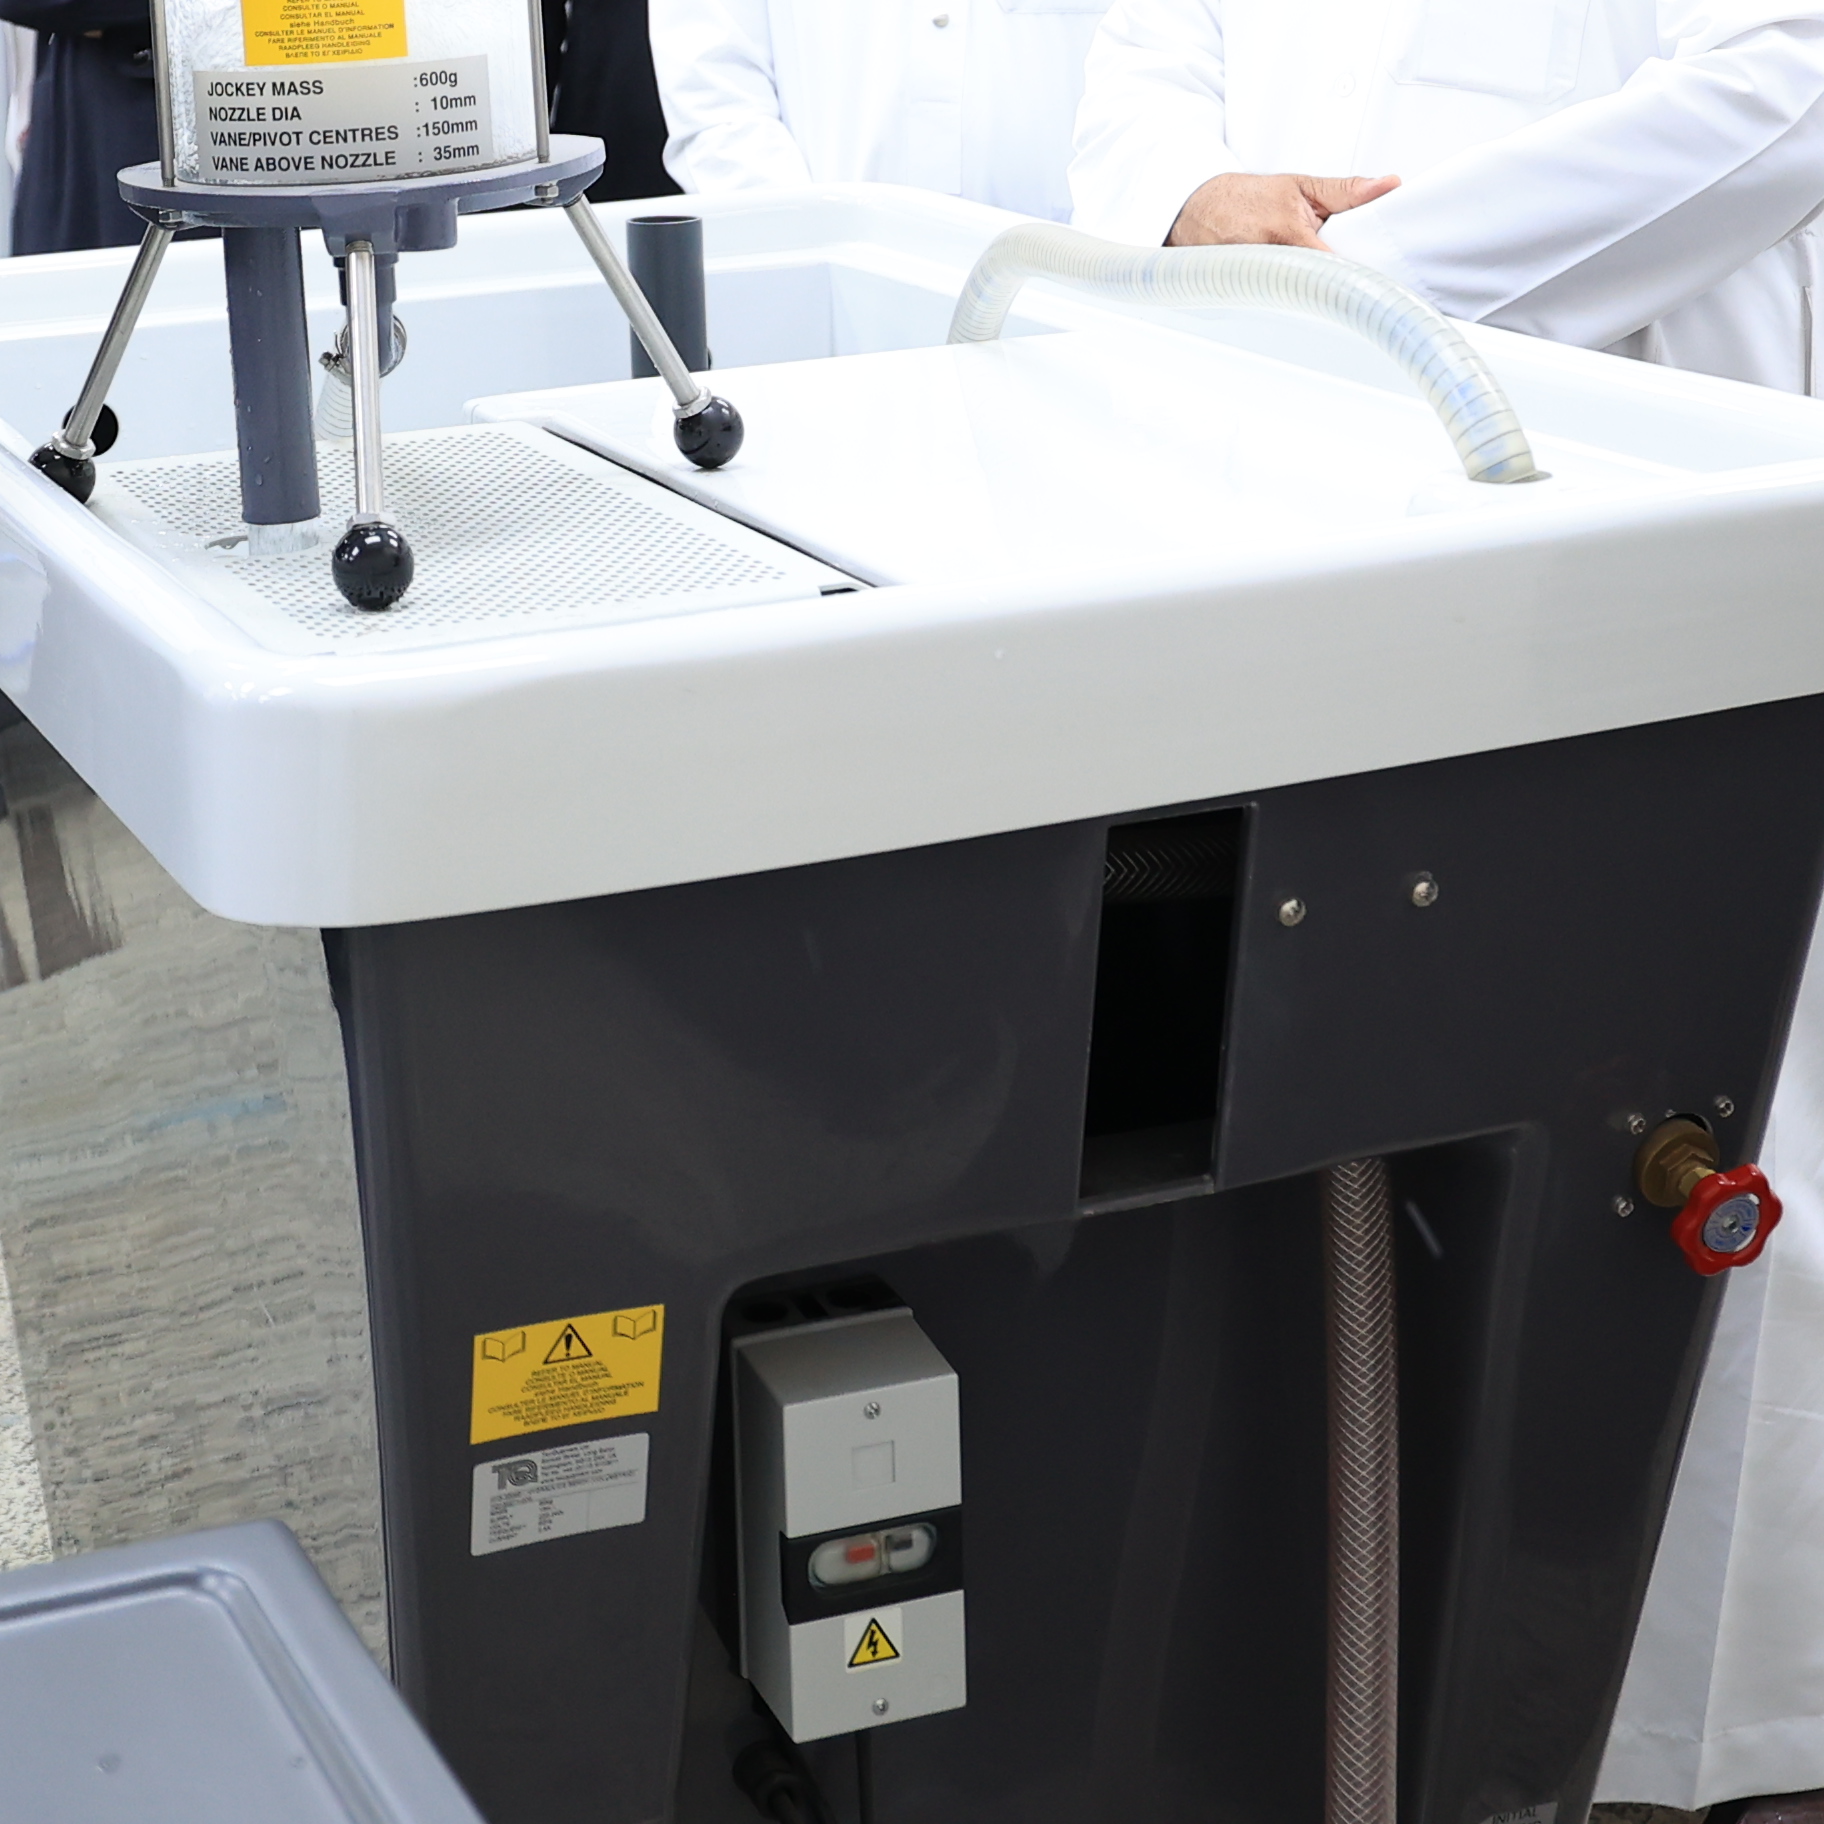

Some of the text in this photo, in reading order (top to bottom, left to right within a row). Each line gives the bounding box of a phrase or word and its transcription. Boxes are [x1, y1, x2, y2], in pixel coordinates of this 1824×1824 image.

[207, 81, 266, 96] JOCKEY
[272, 80, 324, 96] MASS
[209, 107, 266, 121] NOZZLE
[273, 106, 301, 121] DIA
[431, 94, 476, 110] 10mm
[211, 131, 303, 147] VANE/PIVOT
[309, 126, 399, 145] CENTRES
[212, 156, 248, 171] VANE
[254, 154, 315, 172] ABOVE
[321, 151, 396, 170] NOZZLE
[433, 143, 479, 161] 35mm
[491, 1459, 538, 1490] TQ
[1492, 1807, 1536, 1824] INITIAL
